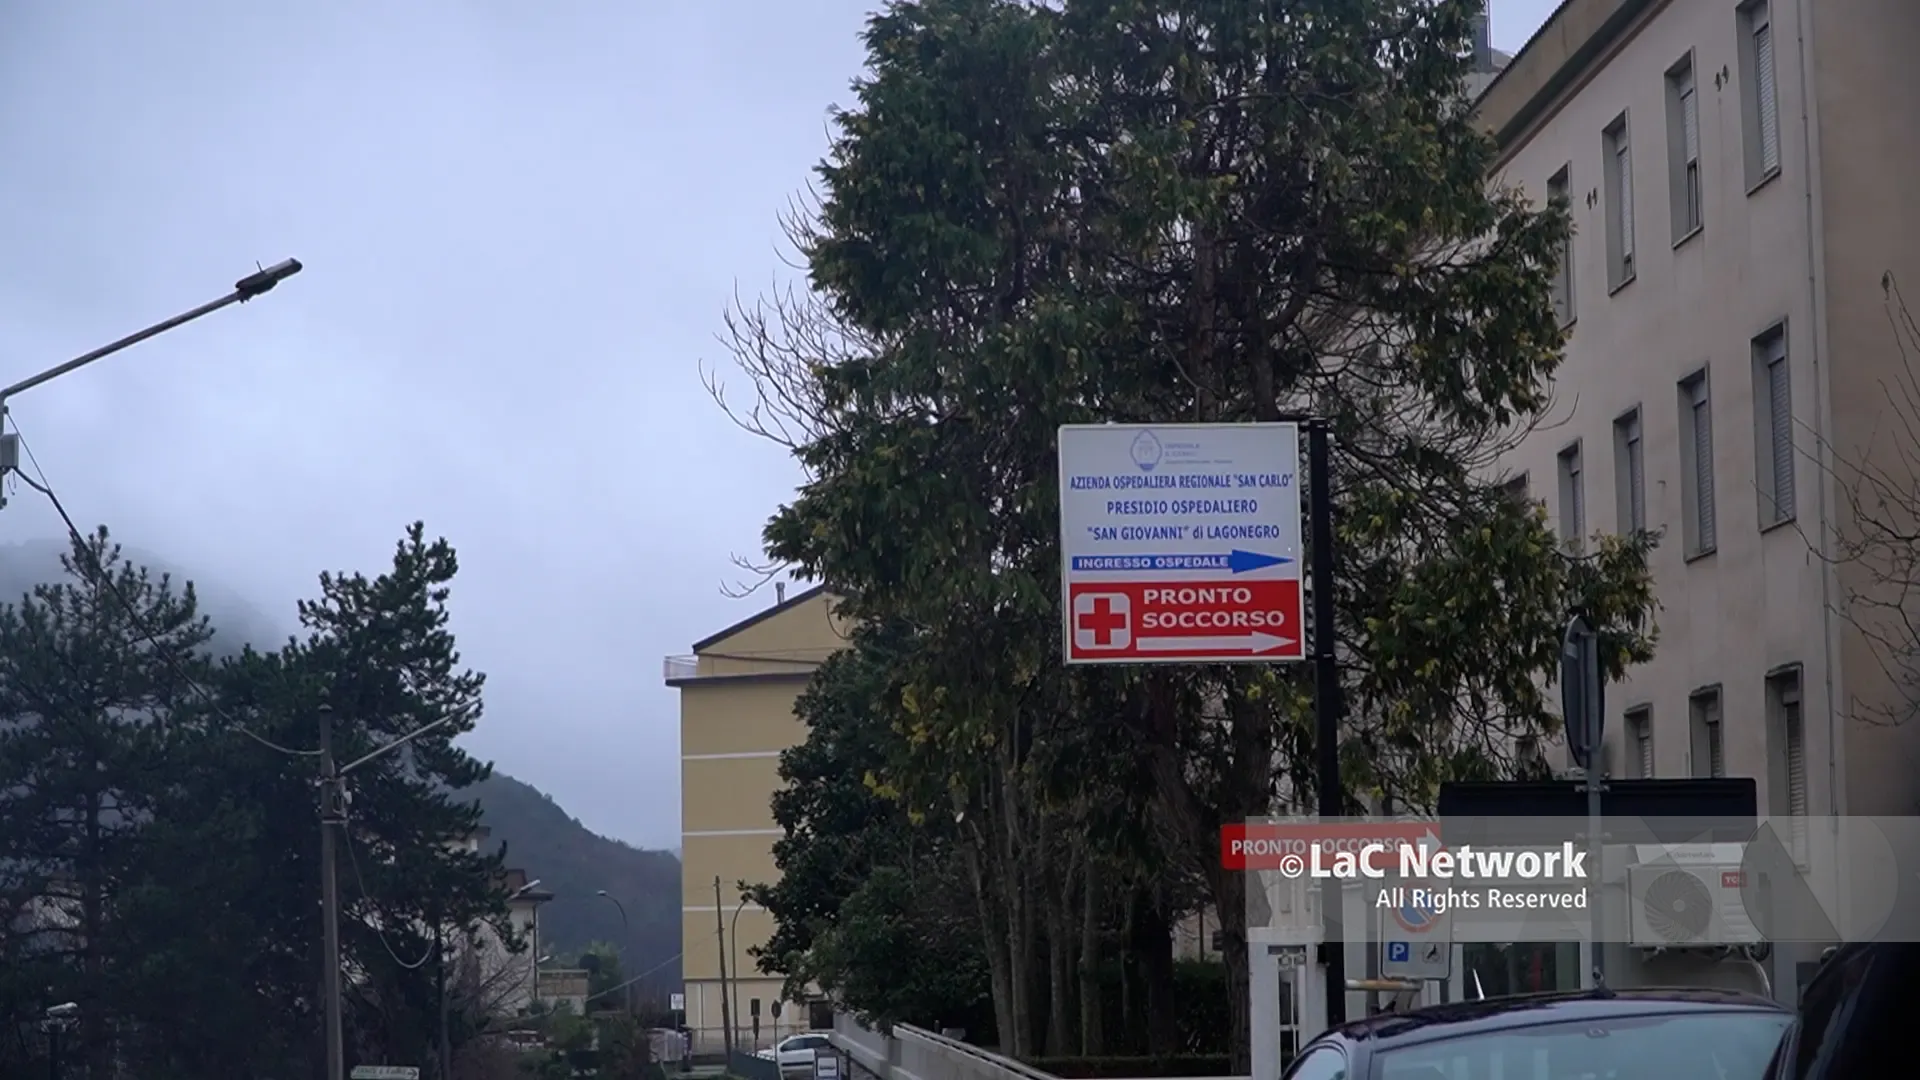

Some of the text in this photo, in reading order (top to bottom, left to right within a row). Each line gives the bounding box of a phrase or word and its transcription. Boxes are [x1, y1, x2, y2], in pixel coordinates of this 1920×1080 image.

[1070, 476, 1111, 490] AZIENDA
[1113, 475, 1176, 490] OSPEDALIERA
[1179, 475, 1231, 489] REGIONALE
[1107, 499, 1258, 515] PRESIDIO OSPEDALIERO
[1193, 525, 1203, 539] di
[1207, 524, 1280, 539] LAGONEGRO
[1078, 556, 1229, 569] INGRESSO OSPEDALE
[1143, 588, 1252, 605] PRONTO
[1142, 611, 1285, 628] SOCCORSO
[1231, 838, 1306, 856] PRONTO
